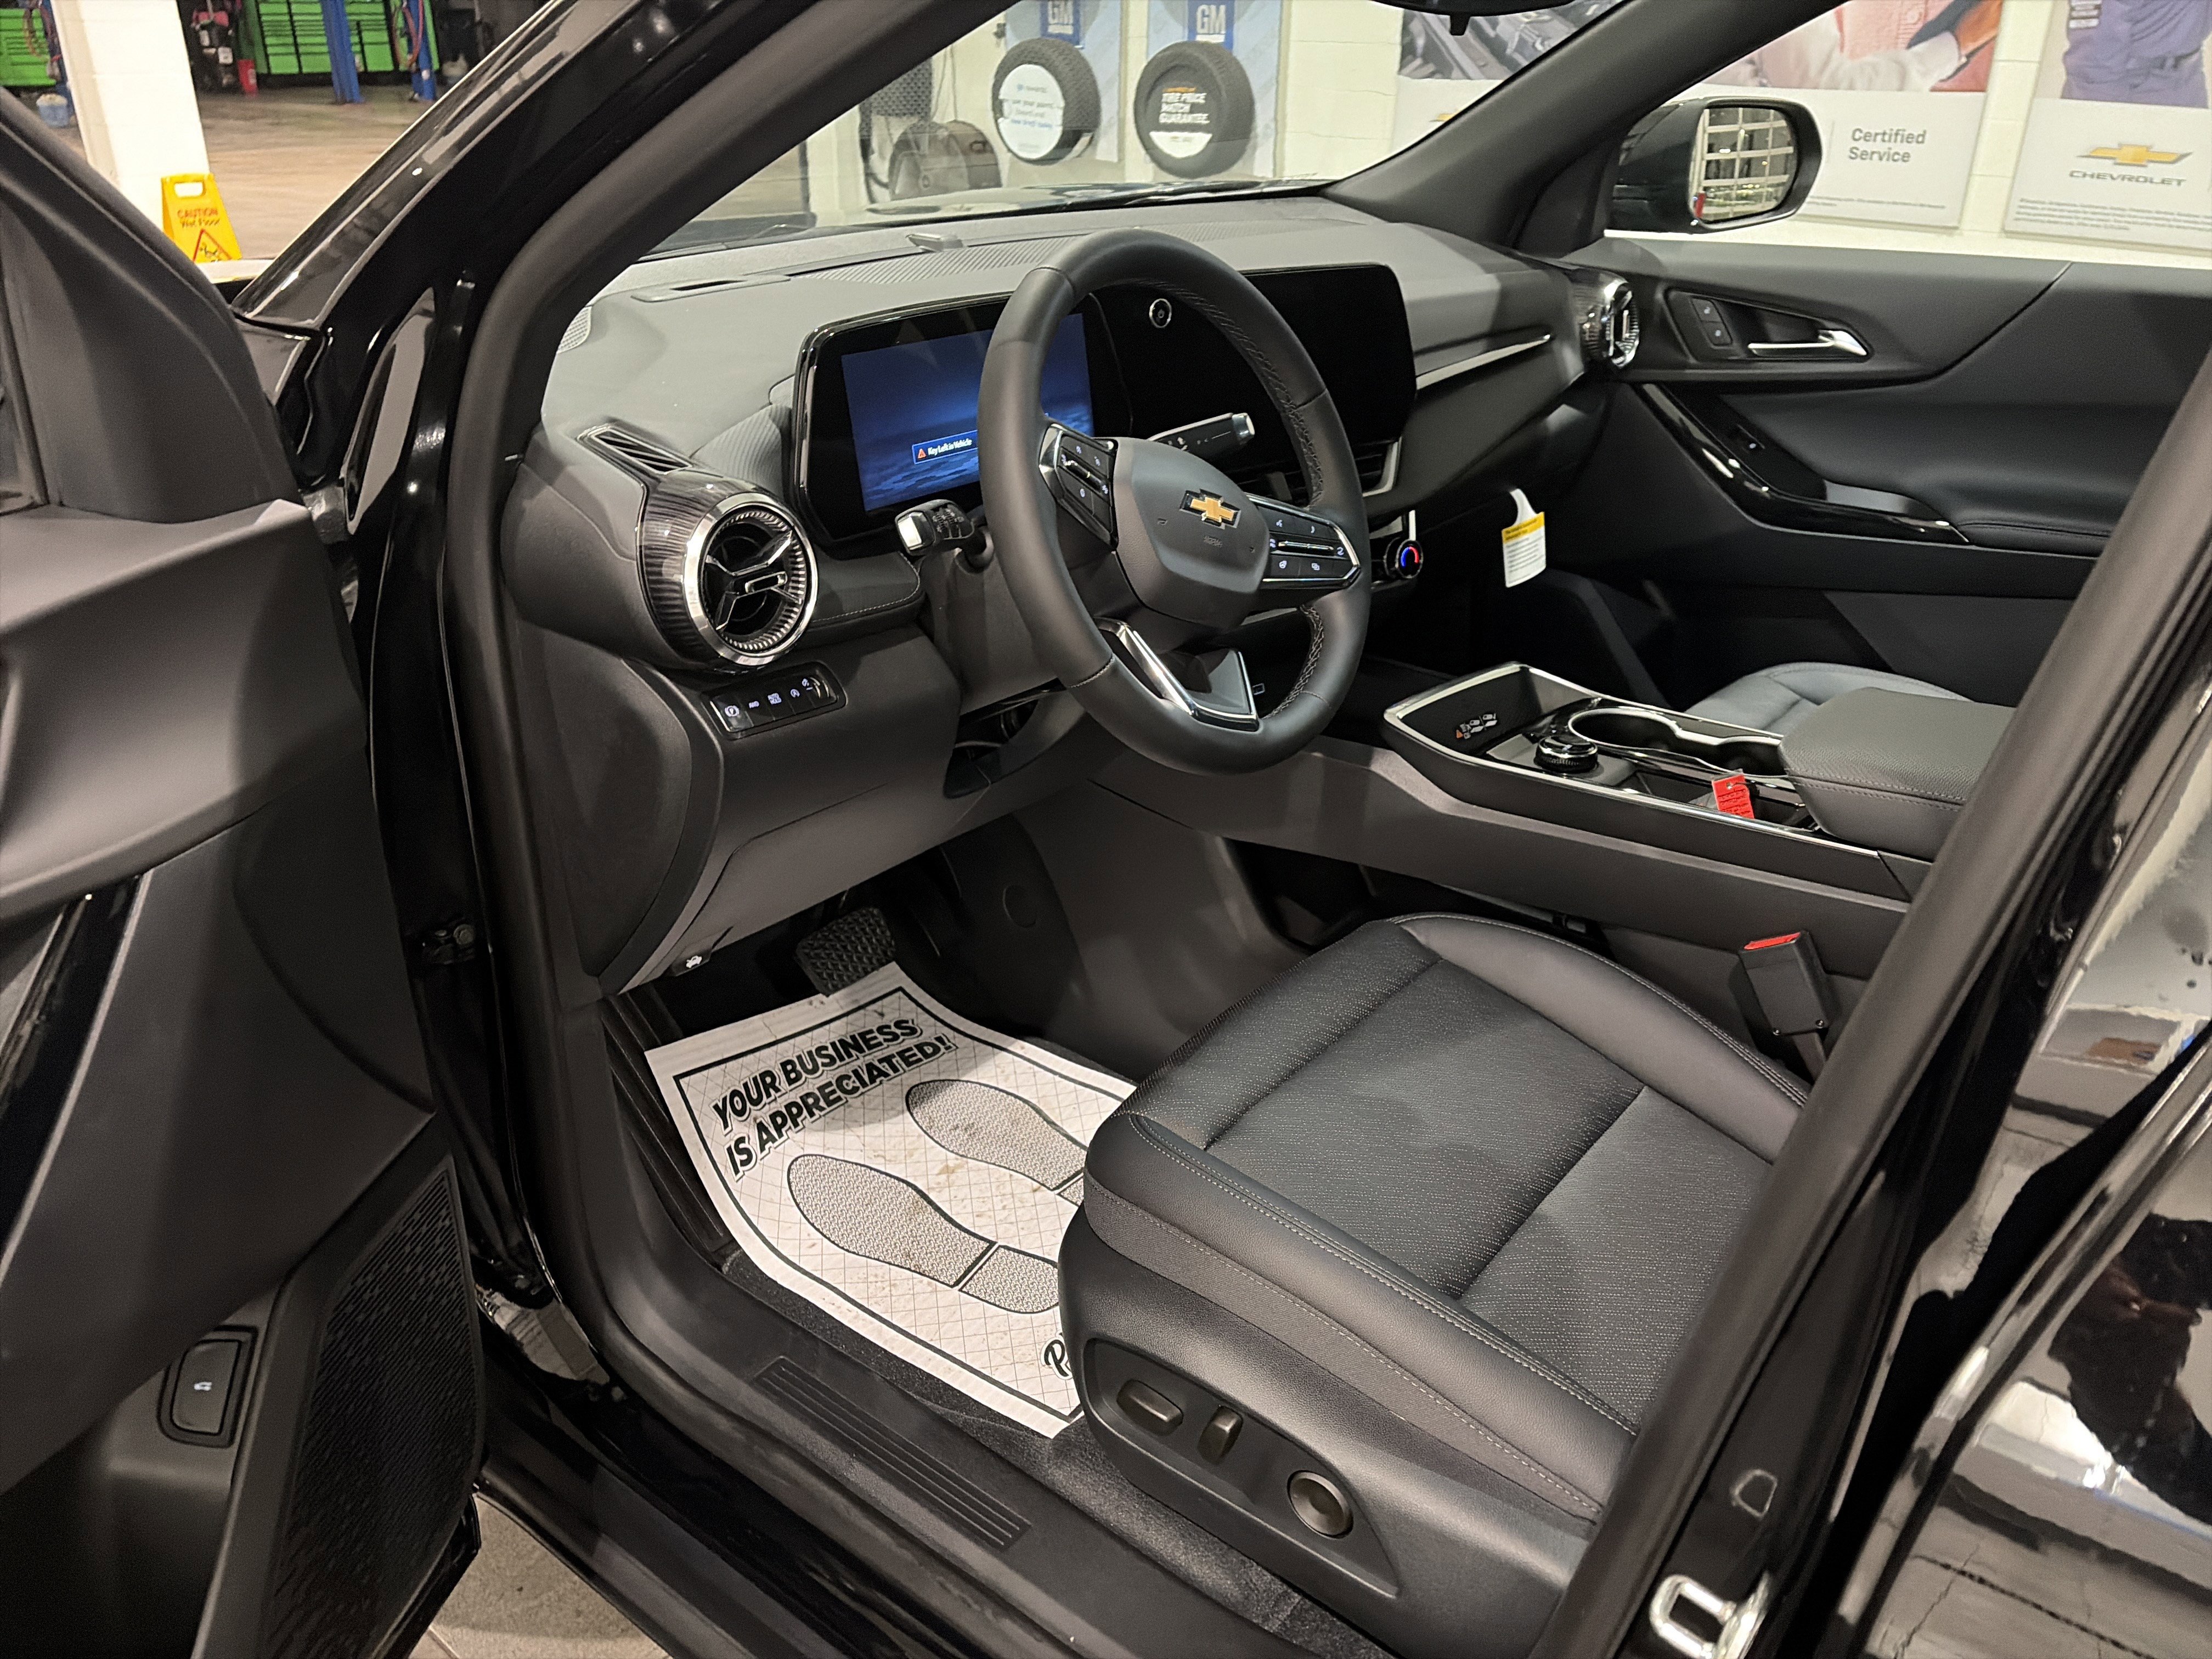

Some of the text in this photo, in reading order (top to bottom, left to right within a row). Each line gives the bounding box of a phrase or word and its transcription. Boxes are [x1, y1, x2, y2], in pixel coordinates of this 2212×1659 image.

[1048, 0, 1074, 24] GM
[1195, 4, 1226, 34] GM
[1851, 127, 1927, 144] Certified
[1848, 146, 1911, 163] Service
[2069, 170, 2187, 187] CHEVROLET
[177, 208, 218, 219] CAUTION
[927, 447, 938, 456] Key
[953, 438, 973, 449] Vehicle
[711, 1018, 922, 1132] YOUR BUSINESS
[725, 1034, 955, 1177] IS APPRECIATED!
